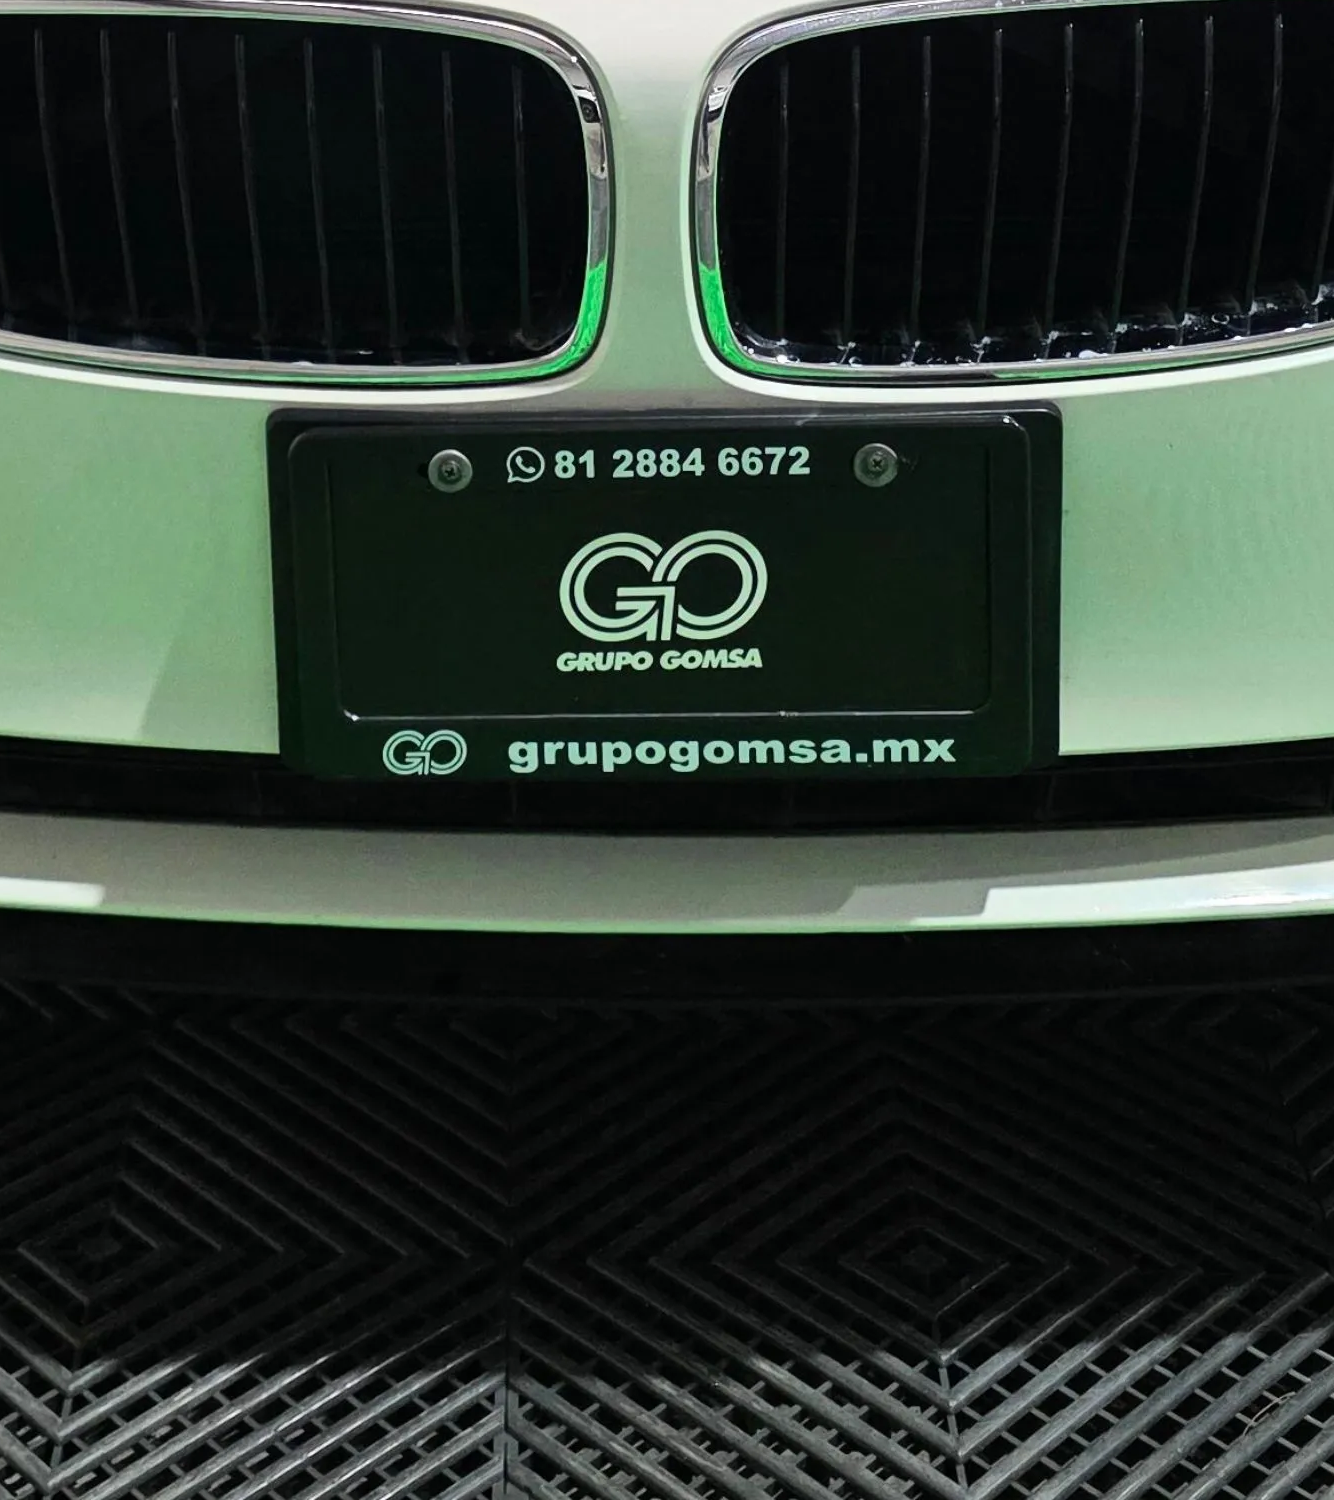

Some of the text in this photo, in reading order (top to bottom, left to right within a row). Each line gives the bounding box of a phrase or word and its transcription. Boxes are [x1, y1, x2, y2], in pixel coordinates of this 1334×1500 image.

[554, 446, 811, 479] 81 2884 6672
[556, 647, 764, 673] GRUPO GOMSA
[508, 737, 957, 774] grupogomsa.mx
